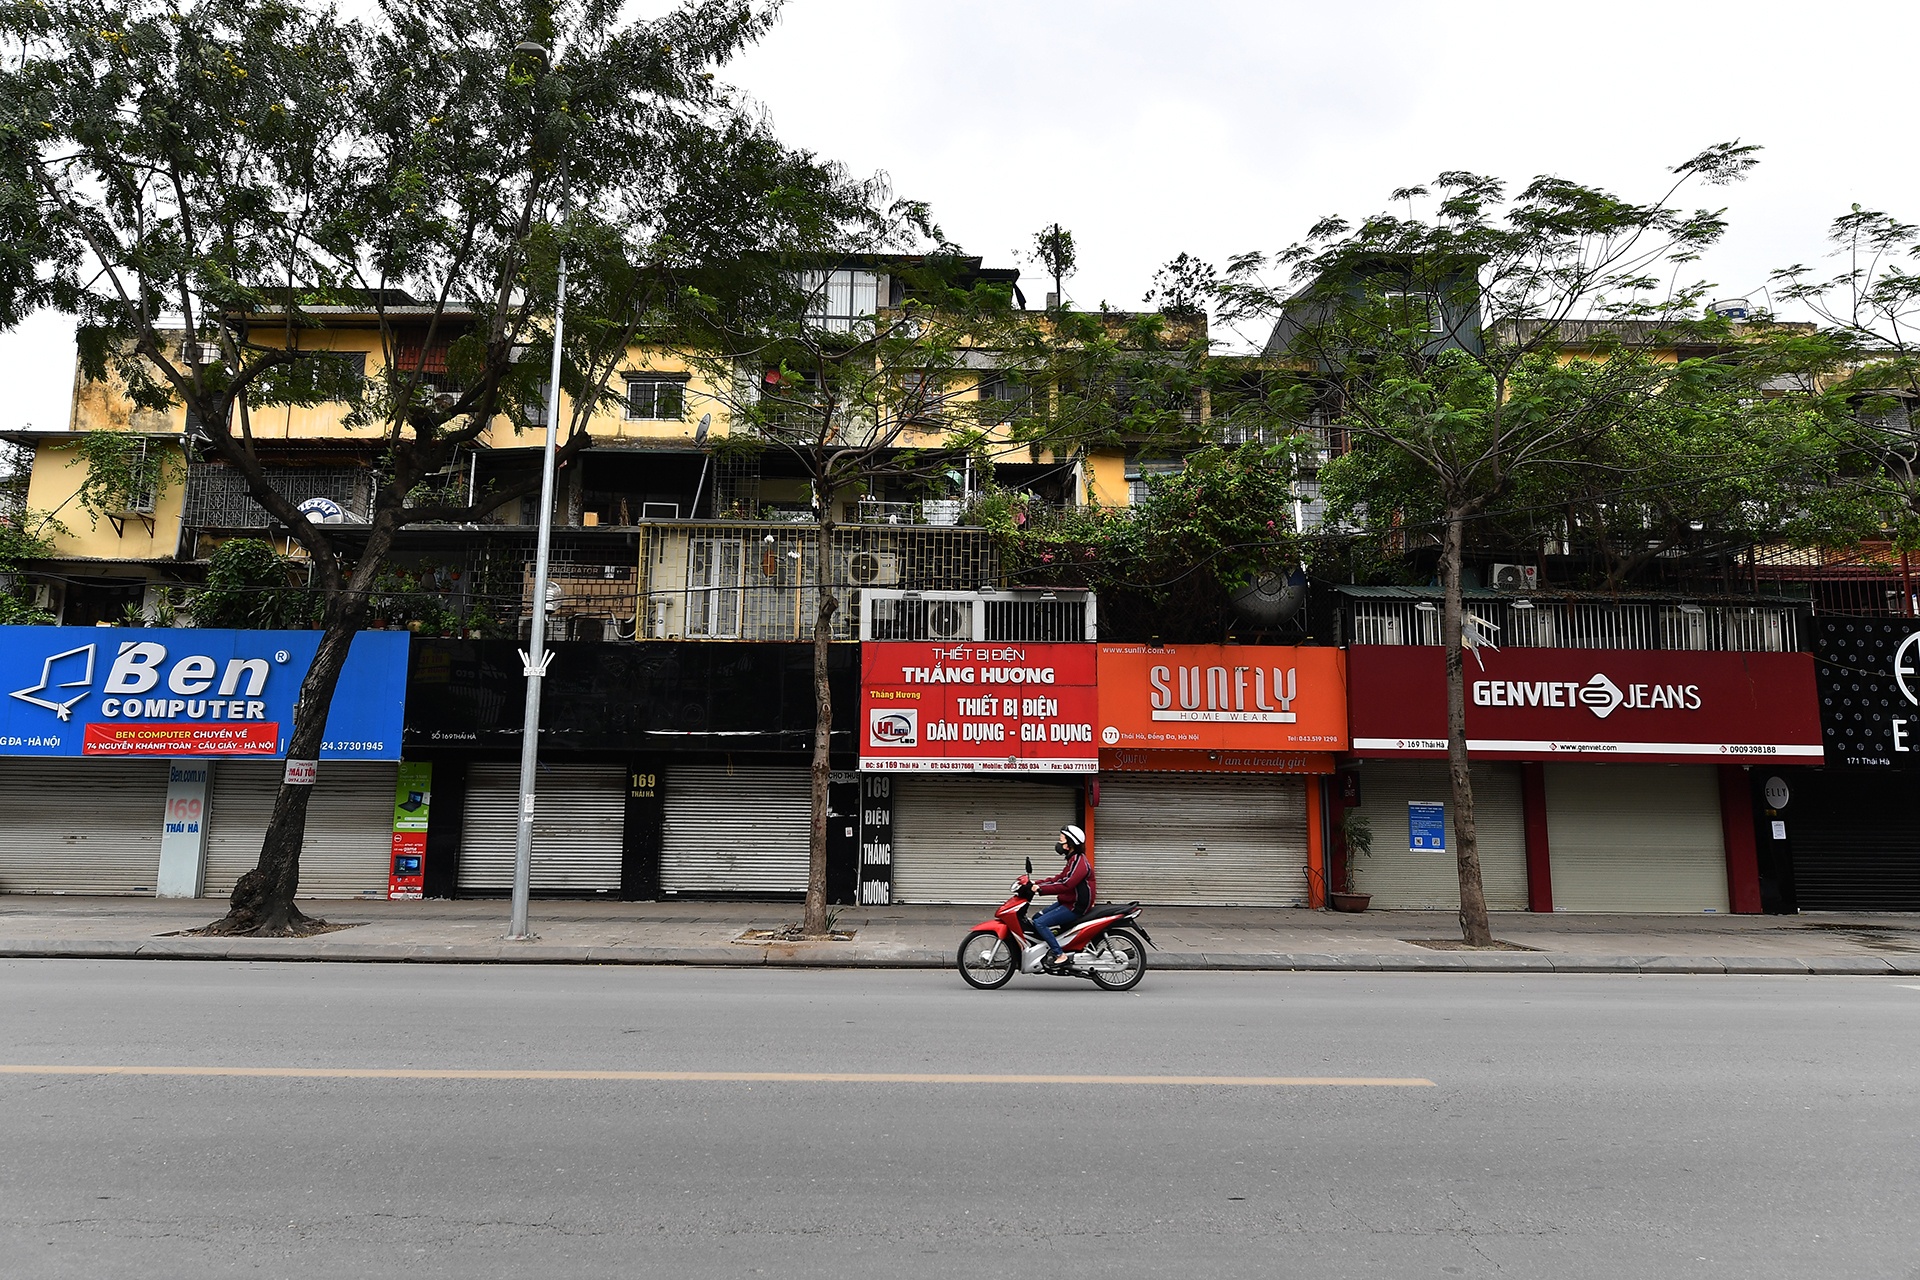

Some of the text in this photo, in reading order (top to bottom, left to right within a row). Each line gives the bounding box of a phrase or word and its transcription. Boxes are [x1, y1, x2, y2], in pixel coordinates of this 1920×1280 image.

[932, 643, 1025, 662] THIẾT BỊ ĐIỆN
[103, 641, 271, 697] Ben
[902, 662, 1055, 684] THẮNG HƯƠNG
[1150, 665, 1298, 711] SUNFLY
[1473, 680, 1702, 710] GENVIET JEANS
[101, 698, 267, 720] COMPUTER
[957, 693, 1058, 719] THIẾT BỊ ĐIỆN
[1180, 712, 1269, 721] HOME WEAR
[115, 731, 135, 739] BEN
[137, 731, 191, 739] COMPUTER
[926, 719, 958, 741] DÂN
[962, 723, 1005, 745] DỤNG
[1020, 723, 1047, 742] GIA
[1050, 723, 1092, 746] DỤNG
[1104, 731, 1118, 739] 171
[8, 736, 22, 746] ĐA
[28, 735, 42, 746] HÀ
[43, 735, 61, 748] NỘI
[86, 742, 97, 750] 74
[135, 742, 166, 750] KHÁNH
[168, 742, 192, 750] TOÀN
[244, 741, 258, 750] HÀ
[258, 741, 275, 751] NỘI
[320, 741, 383, 751] 24.37301945
[1407, 740, 1420, 748] 169
[1729, 746, 1777, 754] 0909398188
[885, 761, 898, 769] 169
[1225, 758, 1242, 767] am
[1243, 758, 1251, 767] a
[1253, 756, 1285, 769] trendy
[1287, 756, 1307, 770] girl
[1847, 757, 1859, 765] 171
[170, 765, 206, 783] Ben.com.vn
[632, 773, 656, 788] 169
[866, 776, 890, 798] 169
[1766, 788, 1787, 797] ELLY
[168, 798, 203, 820] 169
[865, 807, 890, 829] ĐIỆN
[166, 821, 199, 833] THÁI HÀ
[863, 835, 891, 865] THẮNG
[862, 880, 889, 905] HƯƠNG
